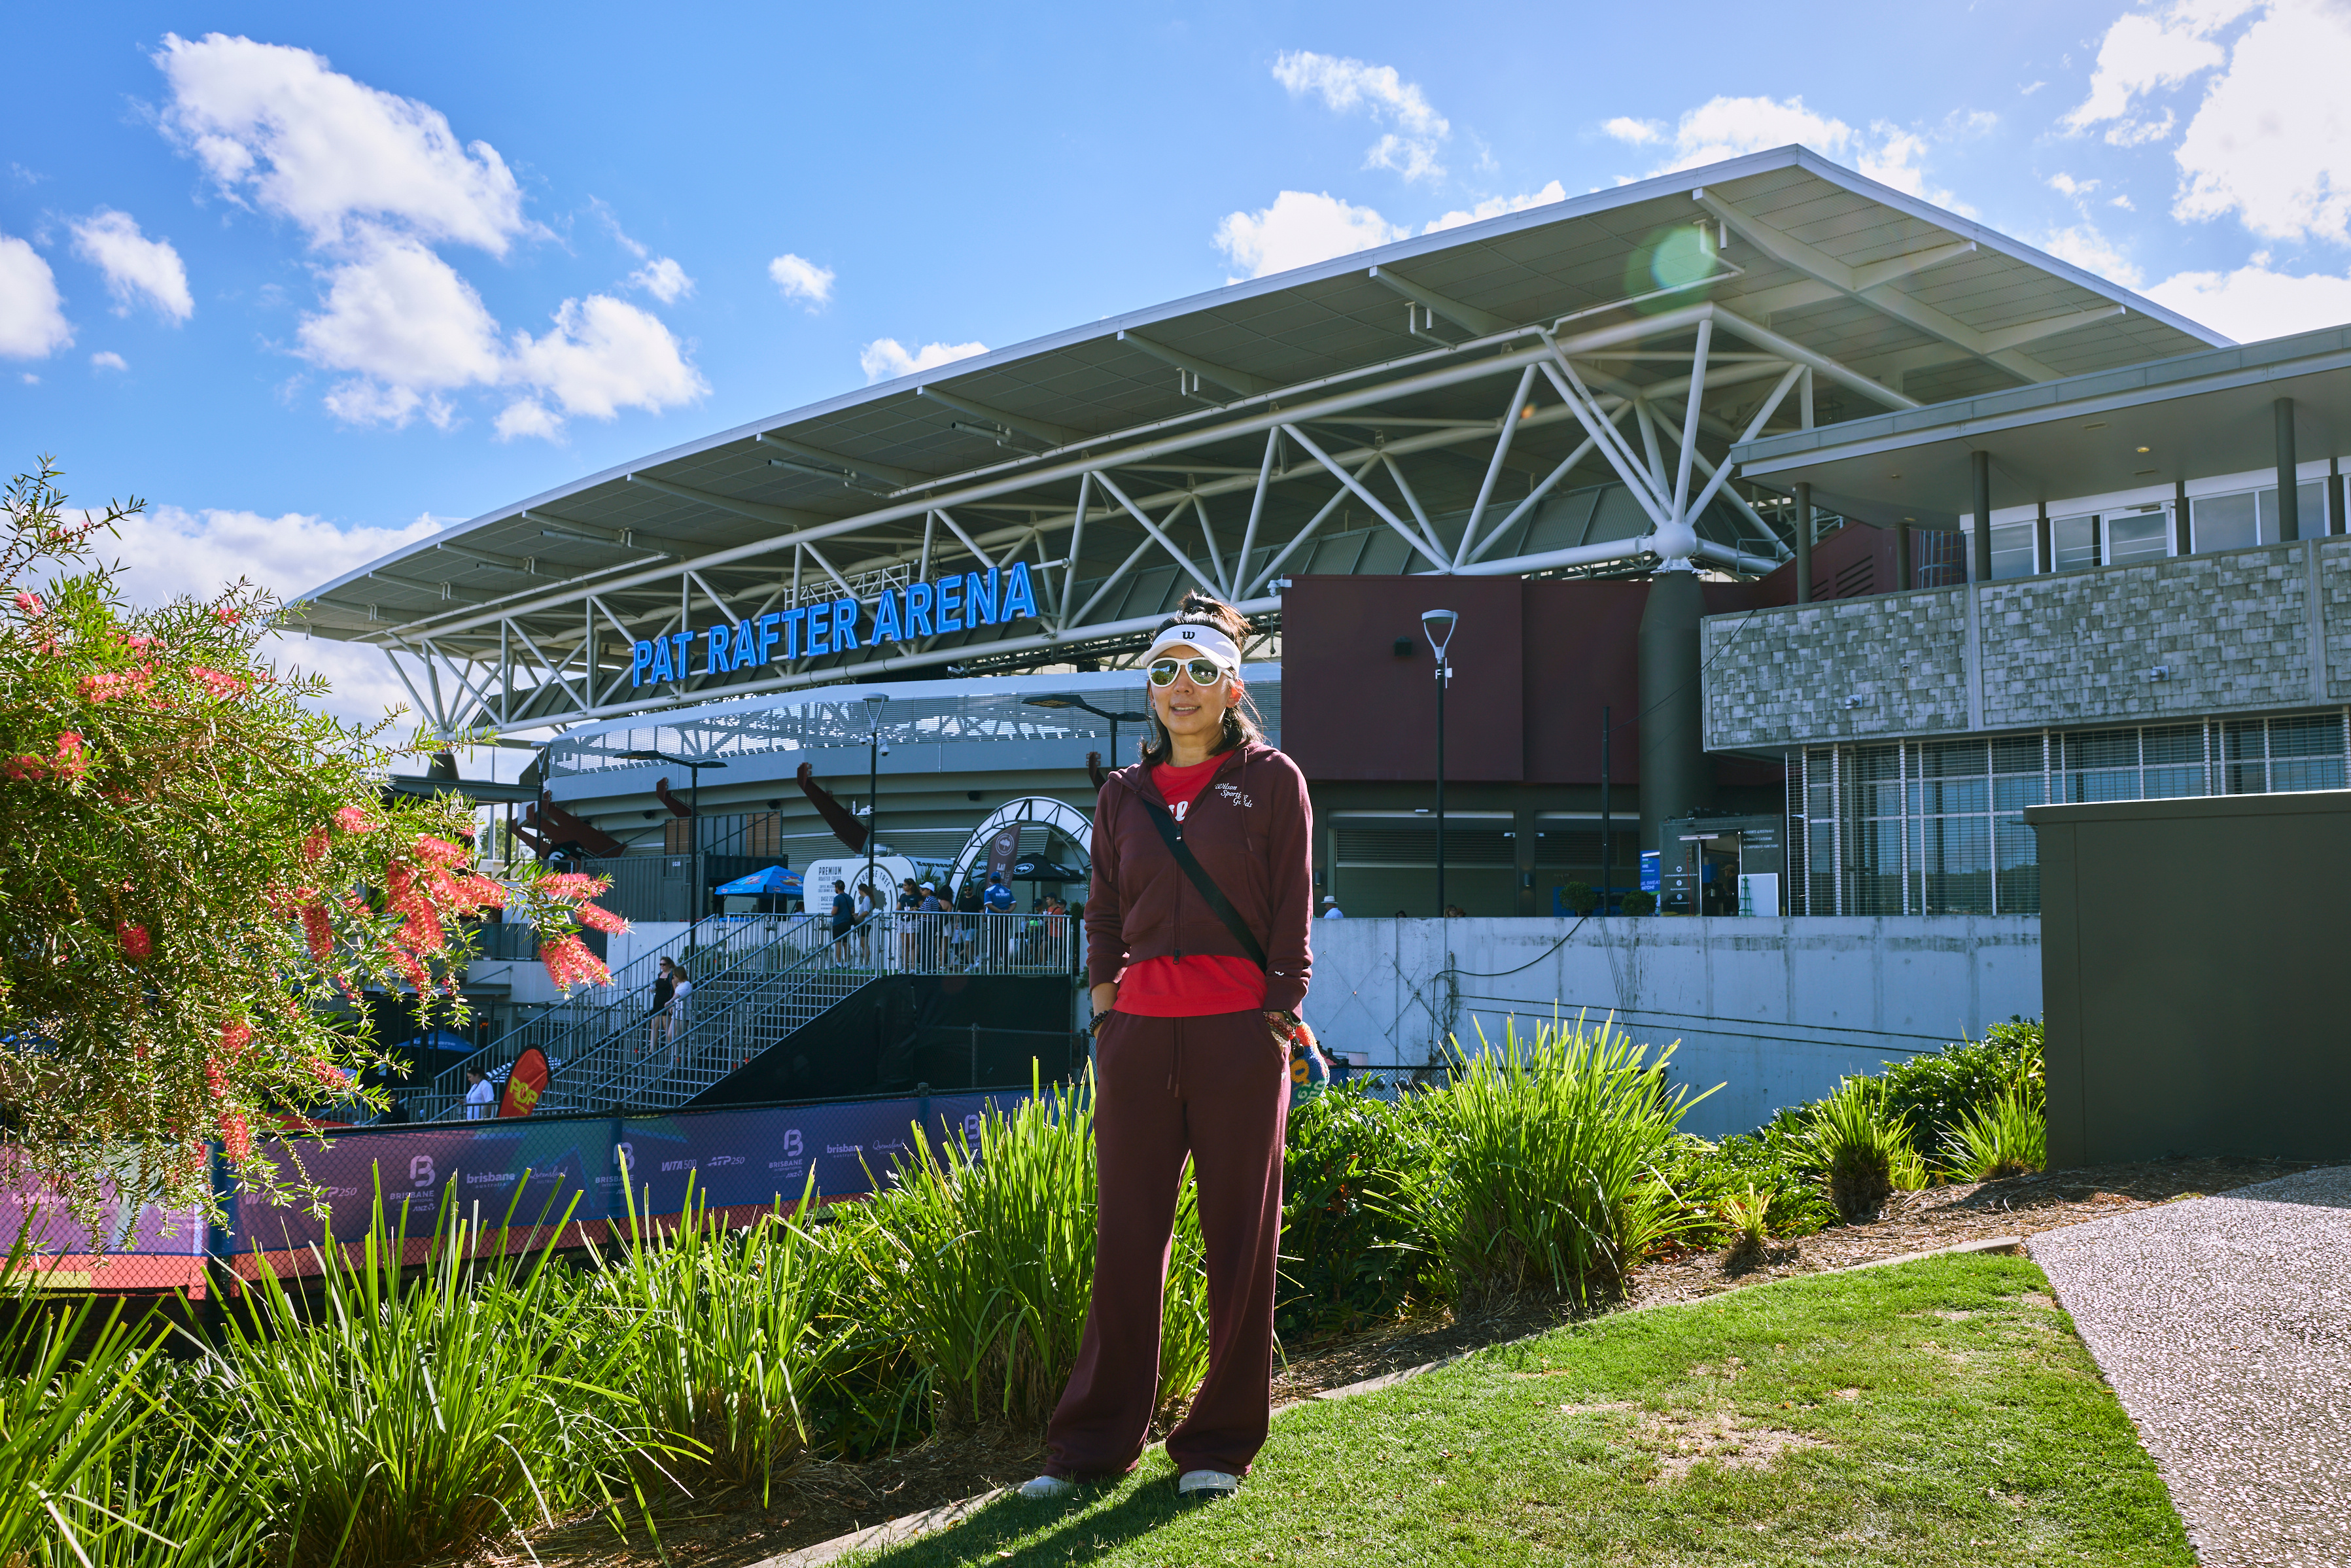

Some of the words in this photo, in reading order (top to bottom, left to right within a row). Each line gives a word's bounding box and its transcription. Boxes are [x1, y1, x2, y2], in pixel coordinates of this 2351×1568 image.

[633, 631, 696, 688] PAT
[708, 597, 860, 674] RAFTER
[871, 561, 1040, 646] ARENA
[1215, 782, 1238, 791] Wilson
[1220, 790, 1249, 801] Sportig
[818, 866, 842, 875] PREMIUM
[856, 870, 878, 887] CABBE
[879, 872, 890, 888] TREE
[509, 1076, 538, 1106] POP
[513, 1100, 528, 1115] tennis
[873, 1138, 904, 1151] Queensland
[661, 1160, 683, 1172] WTA
[684, 1159, 697, 1169] 500
[706, 1156, 731, 1166] ATP
[769, 1159, 803, 1168] BRISBANE
[466, 1172, 515, 1184] brisbane
[529, 1166, 568, 1179] Queensland
[595, 1175, 635, 1183] BRISBAE
[338, 1187, 357, 1197] 250
[390, 1191, 434, 1200] BRISBANE
[12, 1193, 67, 1204] brisbane
[245, 1193, 274, 1205] WTA
